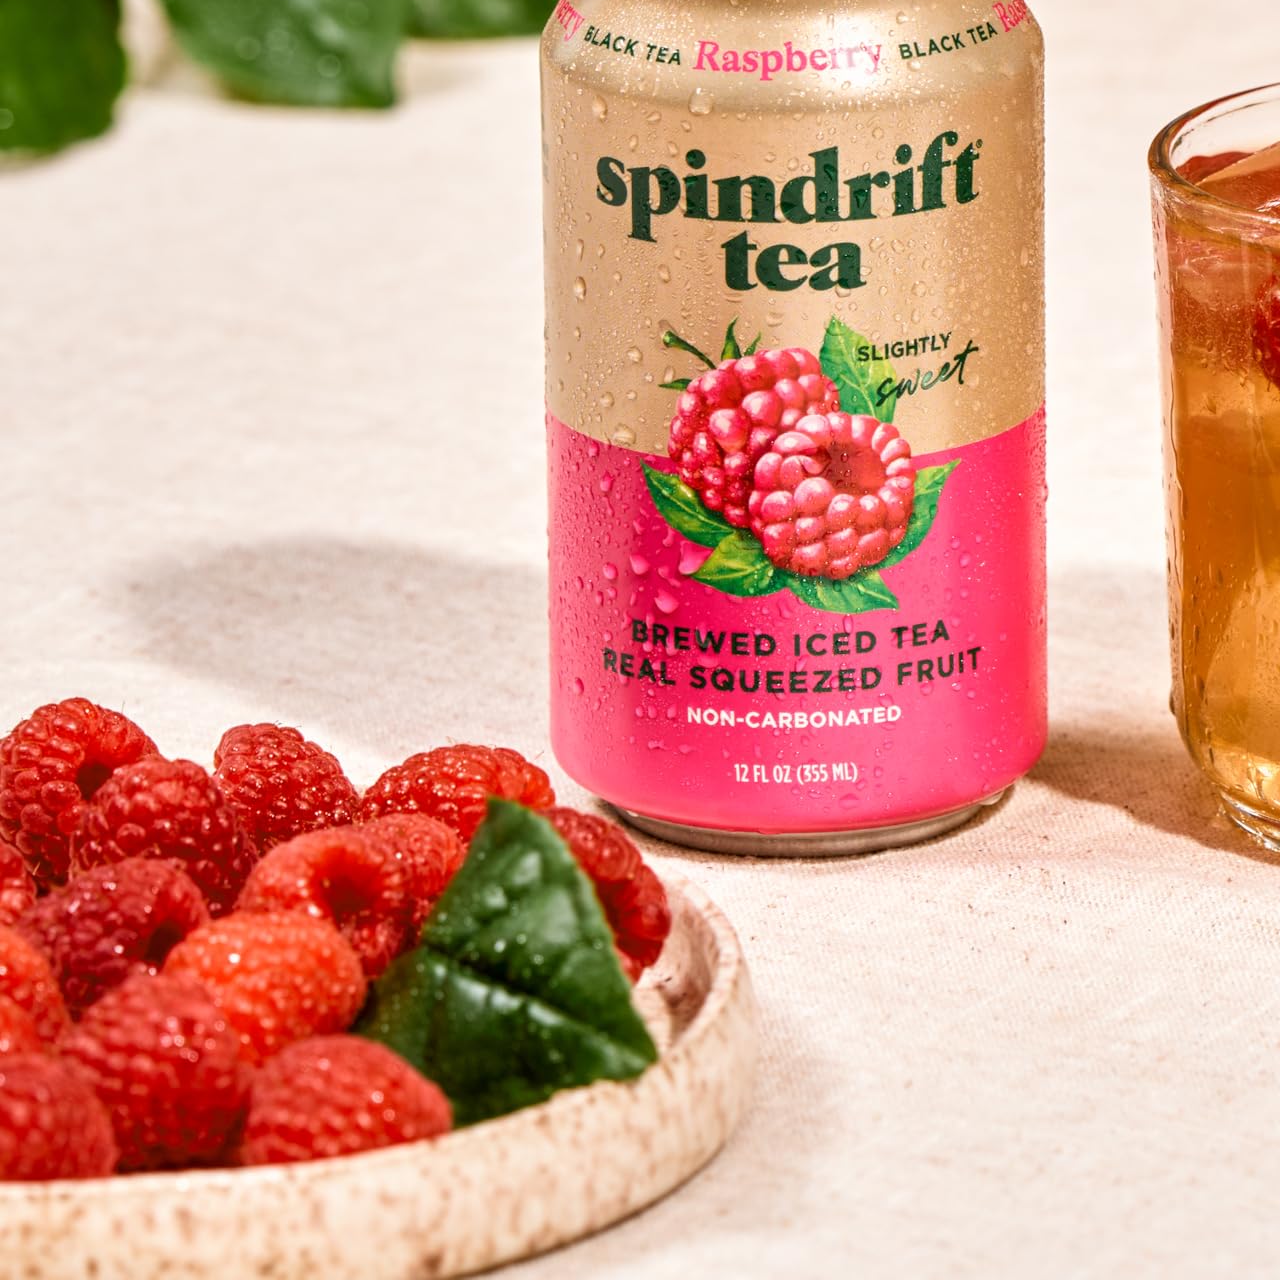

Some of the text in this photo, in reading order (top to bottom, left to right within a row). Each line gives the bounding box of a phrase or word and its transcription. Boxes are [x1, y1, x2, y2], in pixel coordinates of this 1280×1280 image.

[584, 25, 639, 57] BLACK
[646, 43, 681, 66] TEA
[692, 40, 882, 81] Raspberry
[899, 32, 966, 60] BLACK
[966, 22, 999, 45] TEA
[596, 130, 979, 242] spindrift
[721, 230, 868, 291] tea
[857, 331, 952, 362] SLIGHTLY
[875, 339, 979, 407] sweet
[632, 619, 950, 657] BREWED ICED TEA
[602, 646, 981, 694] REAL SQUEEZED FRUIT
[687, 705, 902, 729] NON-CARBONATED
[734, 762, 858, 785] 12 FL OZ (355 ML)
